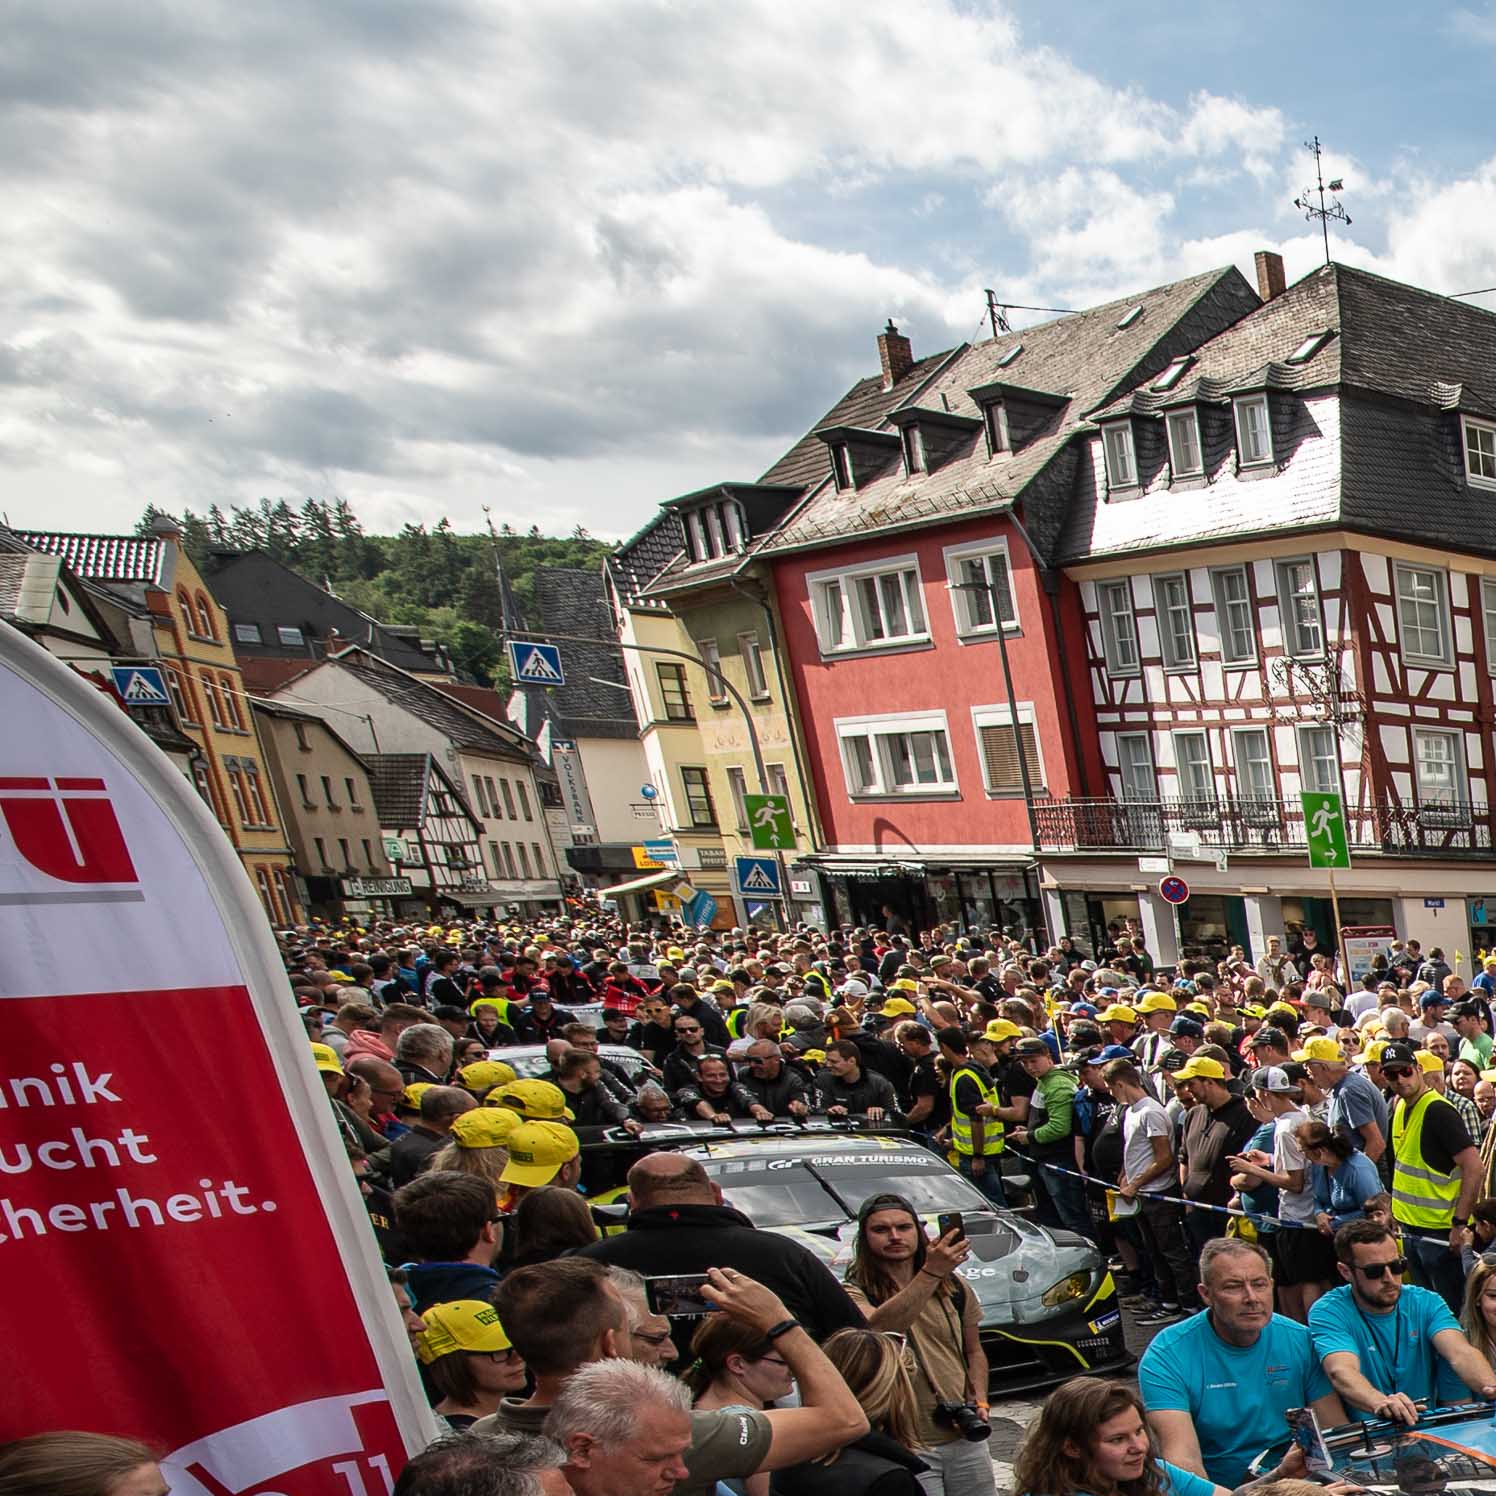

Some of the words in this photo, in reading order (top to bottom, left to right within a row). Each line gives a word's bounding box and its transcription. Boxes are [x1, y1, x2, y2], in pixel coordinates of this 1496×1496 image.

[563, 755, 586, 824] VOLKSBANK
[362, 879, 411, 894] REINIGUNG
[0, 1062, 122, 1109] nik
[811, 1156, 855, 1164] GRAN
[859, 1156, 926, 1165] TURISMO
[0, 1179, 277, 1245] herheit.
